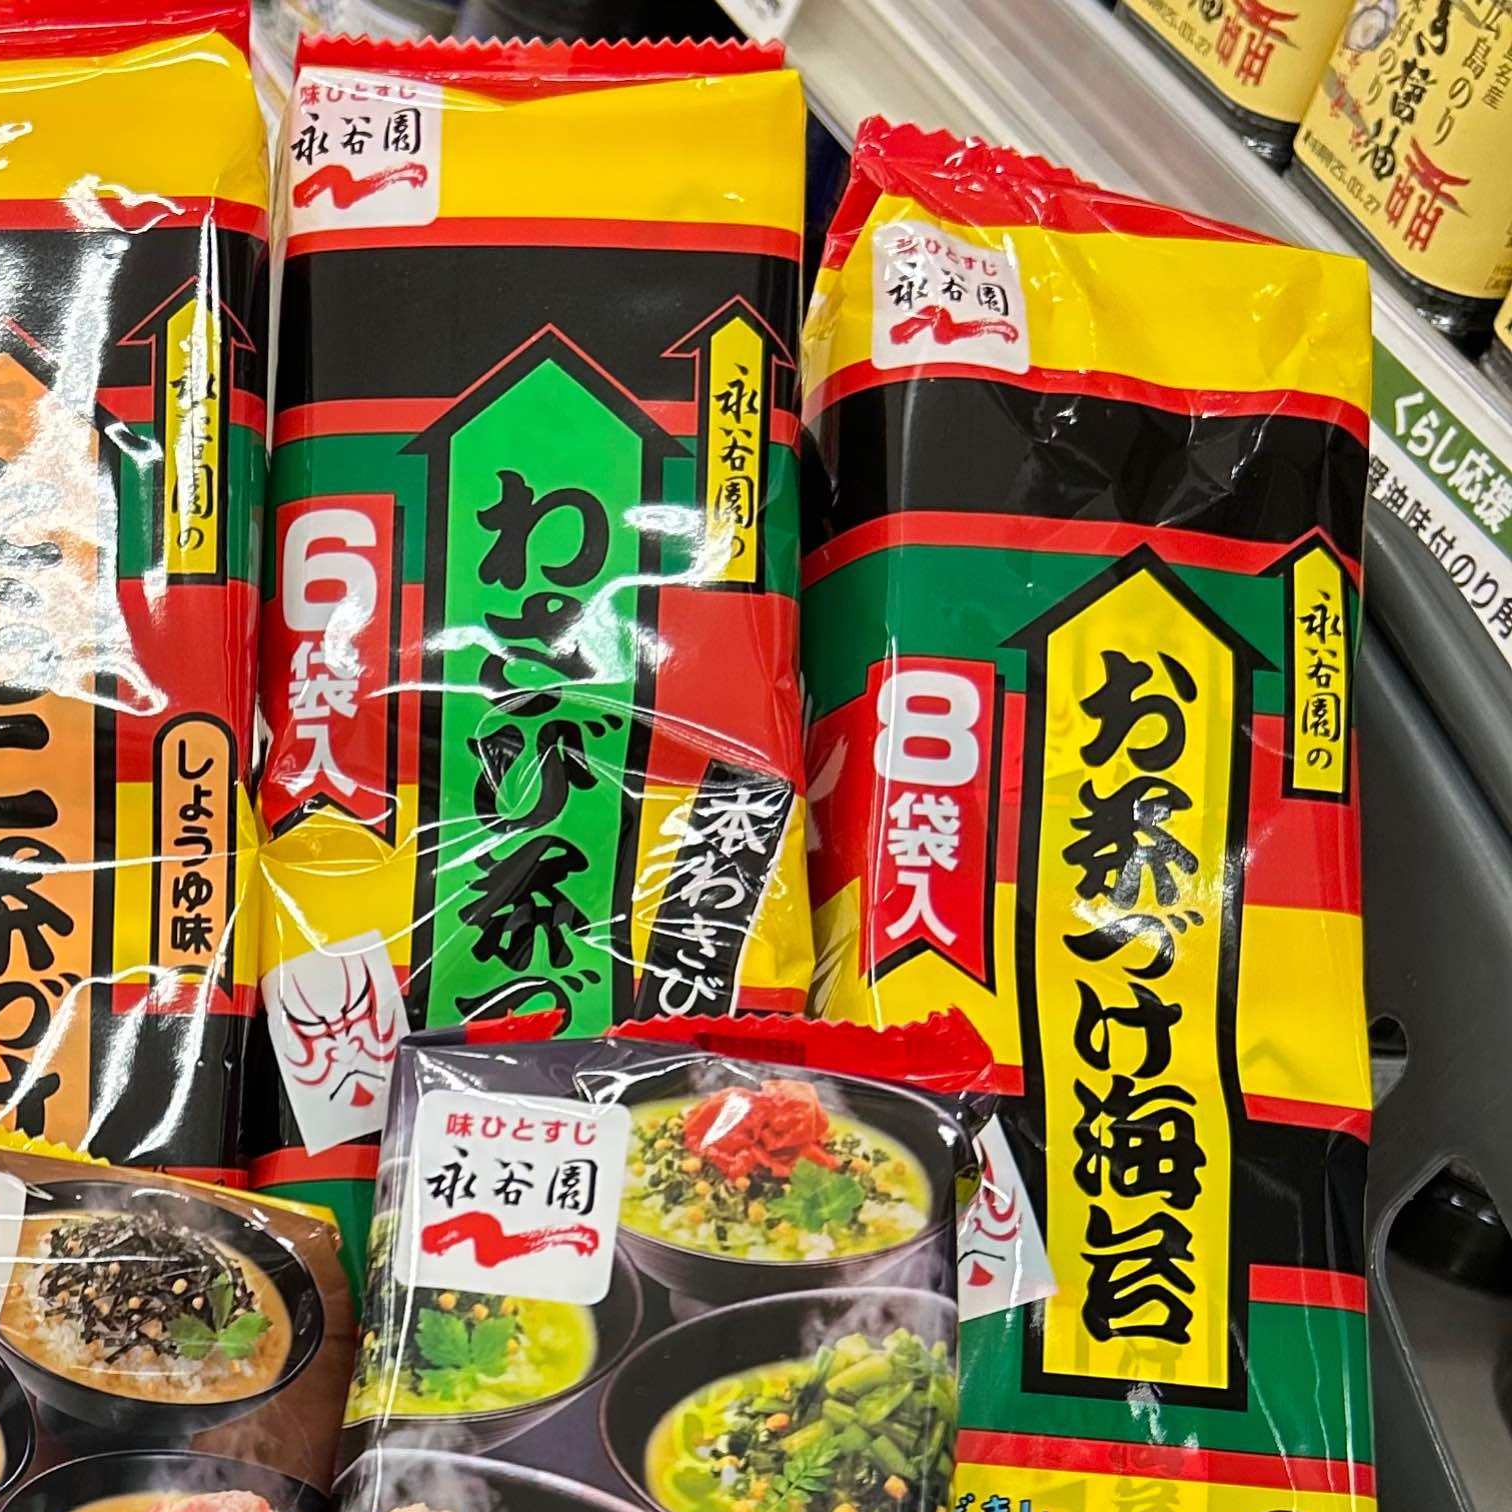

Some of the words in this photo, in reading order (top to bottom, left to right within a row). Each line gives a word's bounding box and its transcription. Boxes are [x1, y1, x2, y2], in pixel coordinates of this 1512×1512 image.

[290, 106, 423, 166] 永谷園
[299, 81, 418, 105] 味ひとすじ
[888, 266, 1010, 317] 永谷園
[711, 363, 760, 562] 永谷園の
[1394, 390, 1512, 535] くらし応援
[281, 507, 377, 798] 6袋入
[1298, 589, 1346, 771] 永谷園の
[172, 737, 214, 955] しょうゆ味
[873, 670, 982, 947] 8袋入
[656, 788, 785, 1017] 本わさび
[1061, 650, 1209, 1344] お茶づけ海苔
[424, 1145, 599, 1217] 永谷園
[445, 1112, 598, 1144] 味ひとすじ
